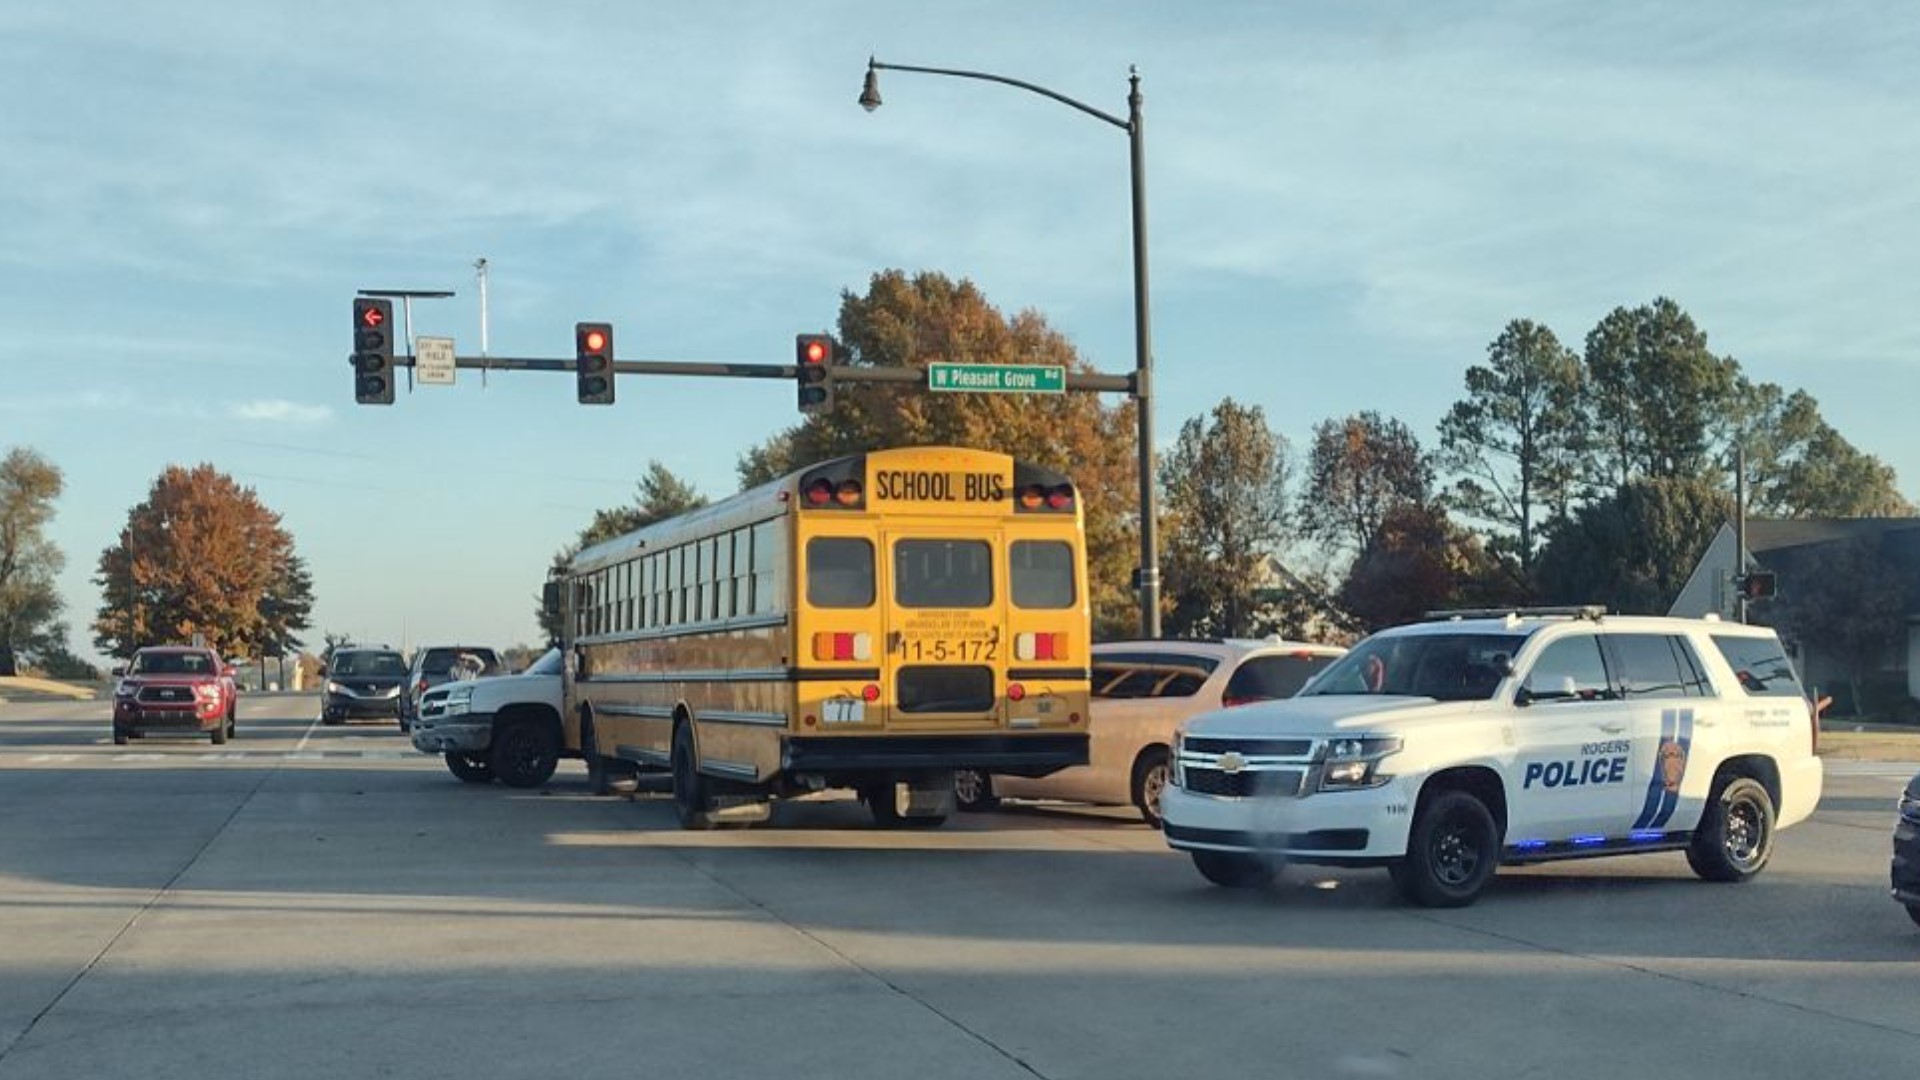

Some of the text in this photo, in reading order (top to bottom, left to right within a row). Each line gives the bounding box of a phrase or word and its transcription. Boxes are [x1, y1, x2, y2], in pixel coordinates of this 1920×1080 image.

[935, 369, 948, 386] W
[951, 369, 1000, 387] Pleasant
[1005, 371, 1037, 388] Grove
[877, 471, 1004, 502] SCHOOL BUS
[902, 640, 997, 661] 11-5-172
[1581, 740, 1630, 755] ROGERS
[1523, 757, 1628, 789] POLICE
